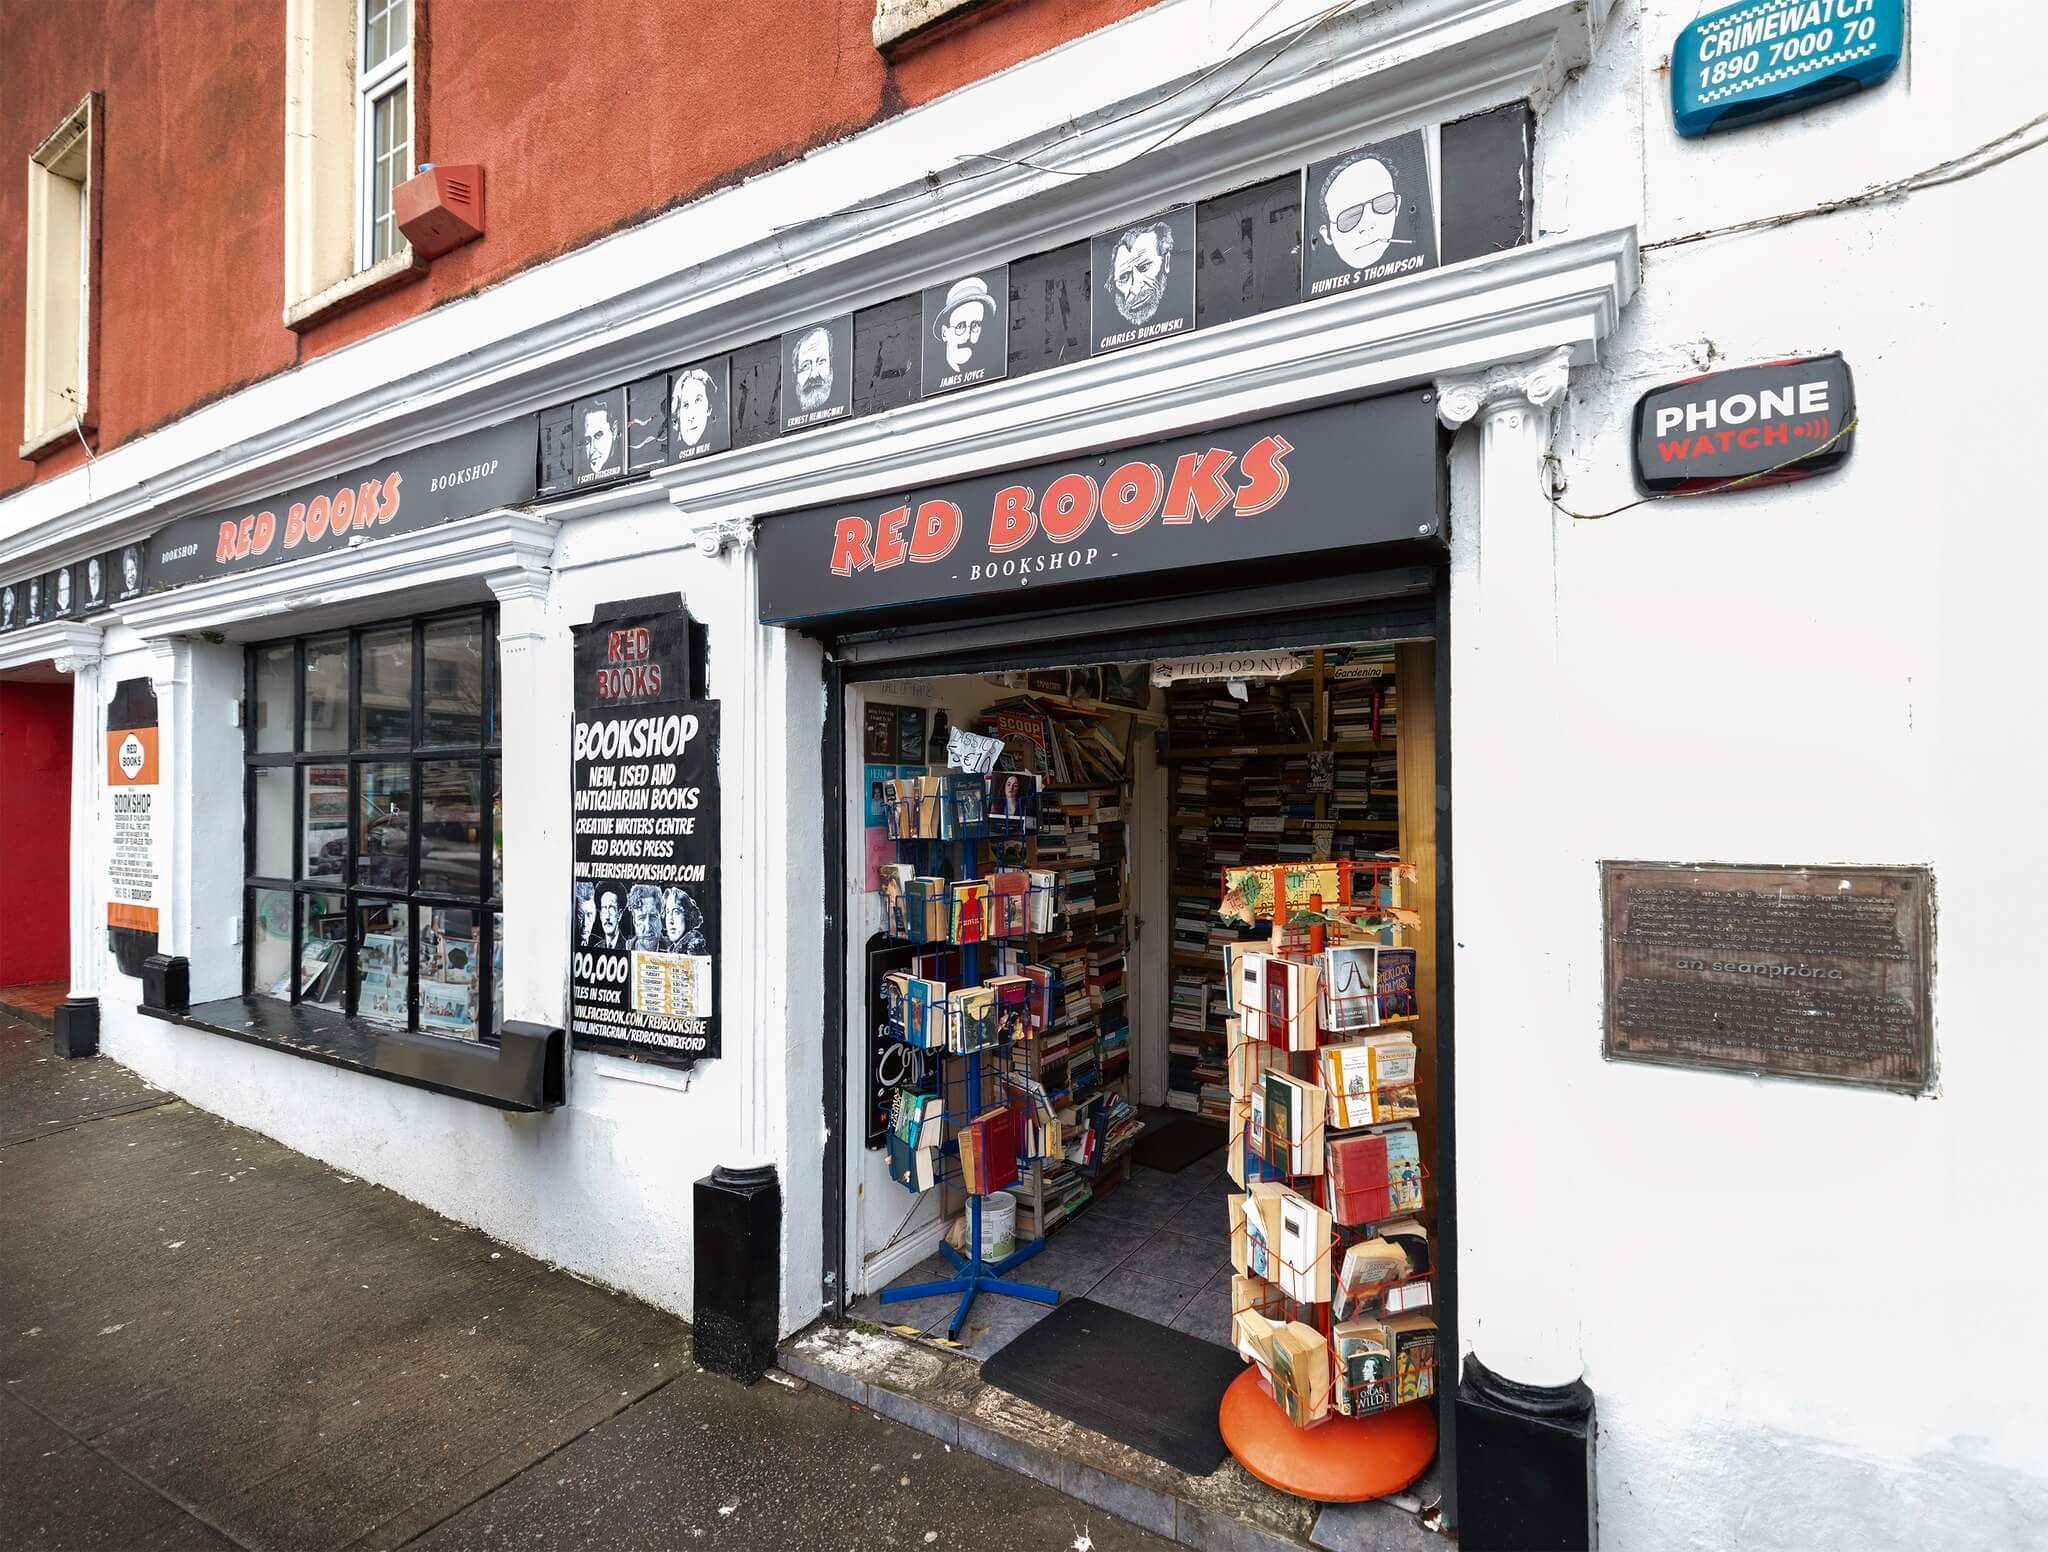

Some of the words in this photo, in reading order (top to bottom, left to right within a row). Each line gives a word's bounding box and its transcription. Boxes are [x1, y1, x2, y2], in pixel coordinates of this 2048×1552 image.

[1699, 0, 1873, 62] CRIMEWATCH
[1699, 51, 1760, 89] 1890
[1768, 28, 1833, 66] 7000
[1842, 17, 1876, 45] 70
[1311, 274, 1350, 294] HUNTER
[1353, 271, 1361, 284] S
[1364, 254, 1425, 280] THOMPSON
[1100, 330, 1137, 349] CHARLES
[1137, 318, 1184, 340] BUKOWSKI
[940, 373, 962, 388] JAMES
[963, 368, 985, 383] JOYCE
[788, 412, 809, 427] ERNEST
[809, 406, 845, 423] HEMINGWAY
[1656, 381, 1830, 438] PHONE
[1656, 423, 1789, 462] WATCH
[429, 460, 499, 493] BOOKSHOP
[215, 511, 277, 565] RED
[283, 471, 403, 549] BOOKS
[830, 499, 963, 577] RED
[988, 434, 1295, 553] BOOKS
[161, 543, 198, 564] BOOKSHOP
[970, 547, 1099, 581] BOOKSHOP
[607, 628, 650, 662] RED
[1229, 659, 1256, 673] GO
[596, 664, 662, 699] BOOKS
[575, 714, 699, 761] BOOKSHOP
[999, 716, 1041, 734] SCOOP
[122, 756, 141, 767] BOOKS
[126, 744, 137, 754] RED
[589, 765, 617, 789] NEW,
[619, 764, 650, 787] USED
[650, 763, 676, 786] AND
[114, 794, 151, 813] BOOKSHOP
[575, 789, 650, 811] ANTIQUARIAN
[650, 787, 701, 810] BOOKS
[576, 817, 614, 834] CREATIVE
[615, 817, 654, 834] WRITERS
[655, 817, 696, 834] CENTRE
[591, 839, 608, 856] RED
[609, 839, 642, 856] BOOKS
[643, 840, 674, 857] PRESS
[1337, 960, 1371, 993] A
[1677, 958, 1704, 971] an
[589, 987, 598, 1001] IN
[598, 989, 622, 1003] STOCK
[1360, 1386, 1385, 1399] OSCAR
[1360, 1393, 1390, 1409] WILDE
